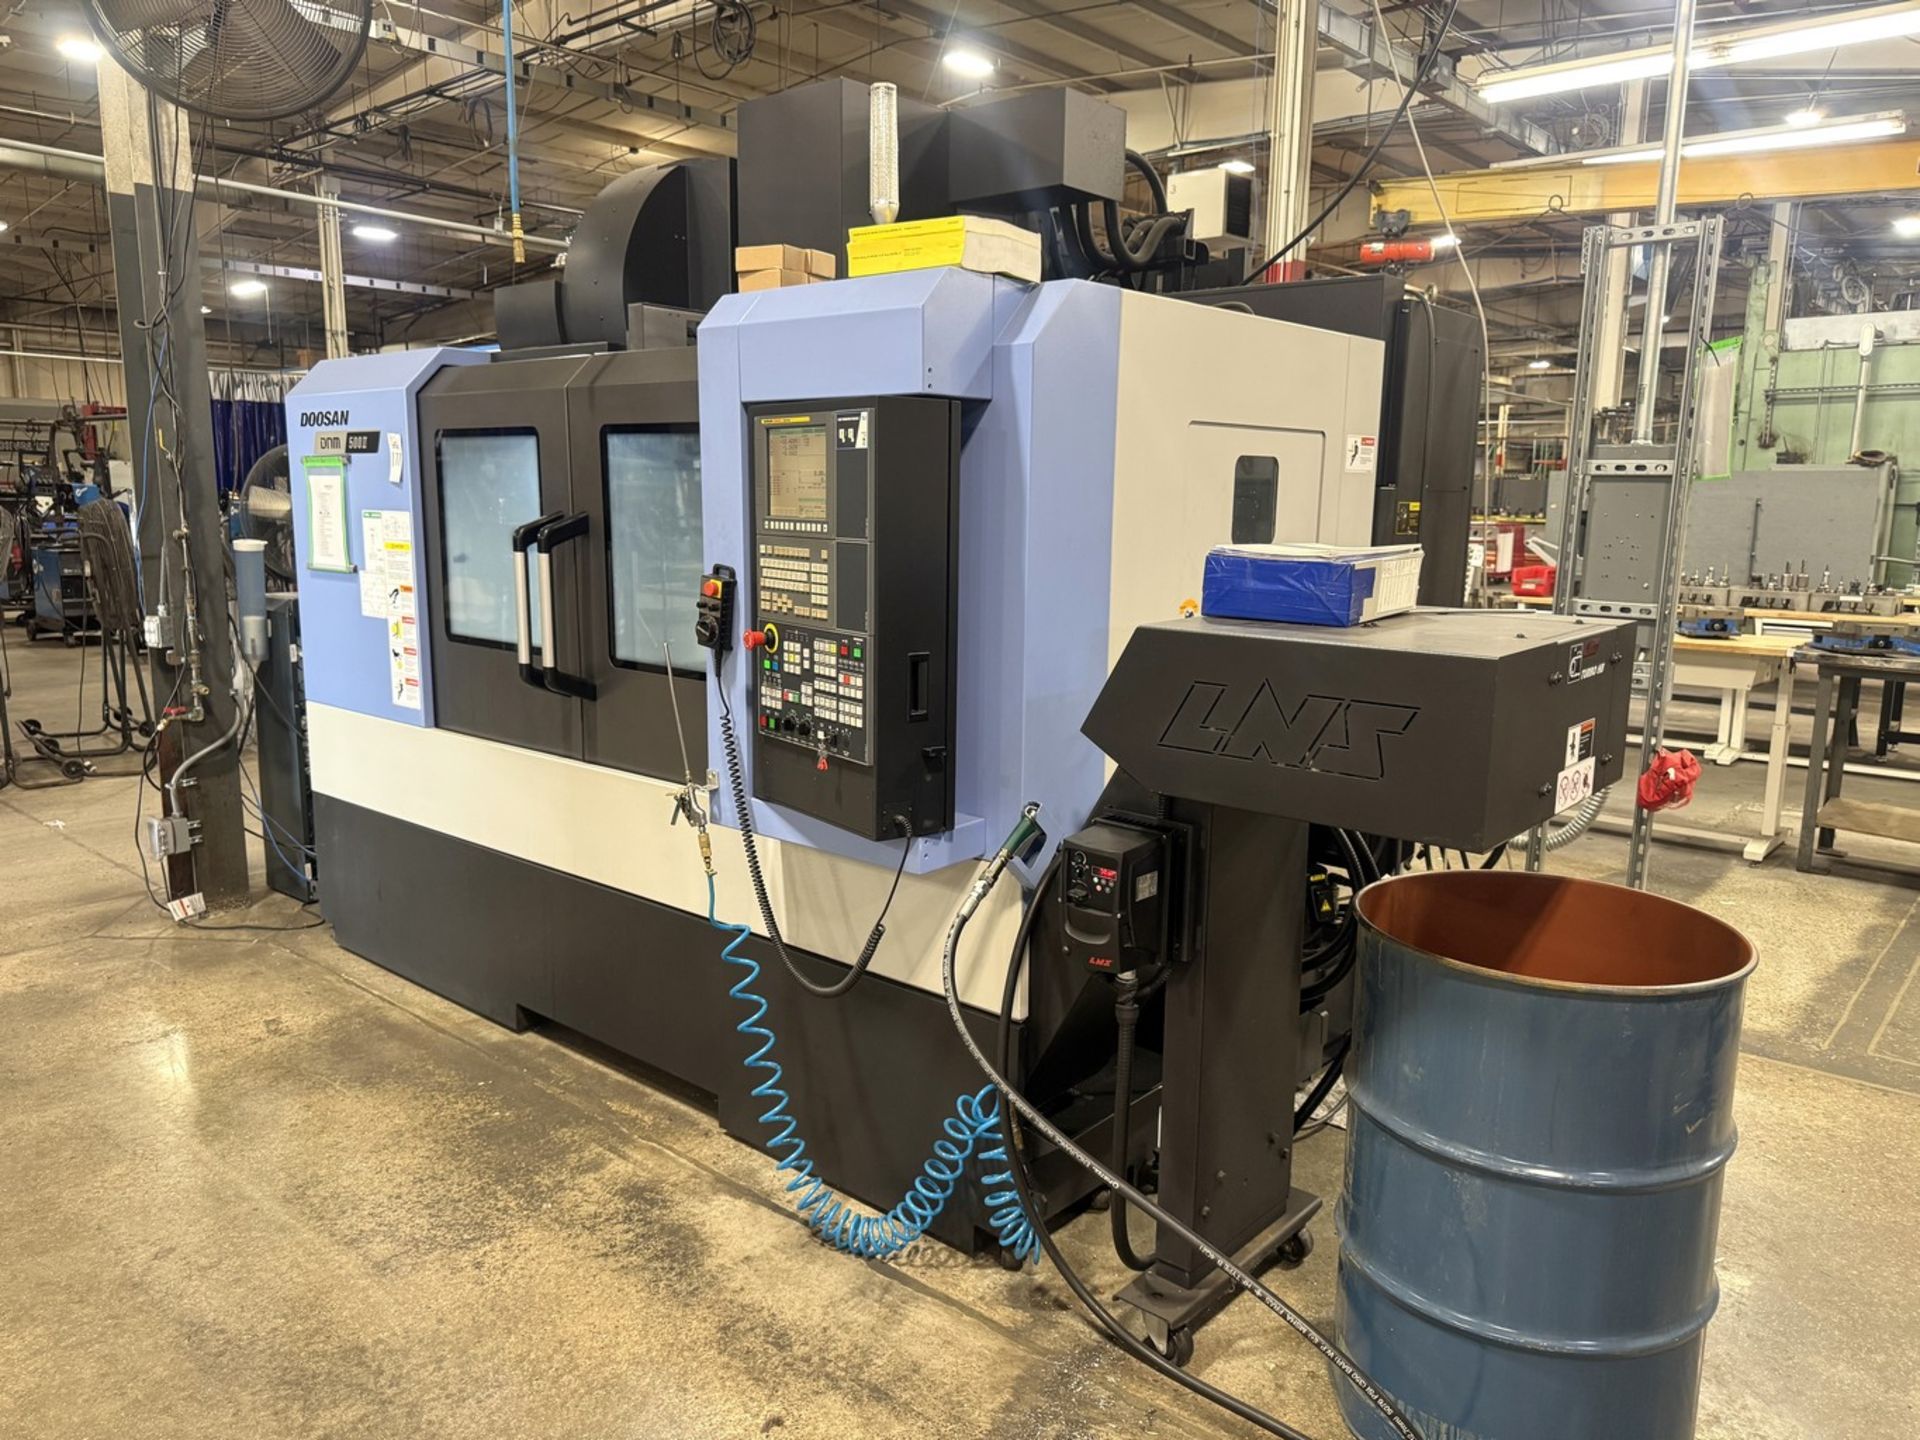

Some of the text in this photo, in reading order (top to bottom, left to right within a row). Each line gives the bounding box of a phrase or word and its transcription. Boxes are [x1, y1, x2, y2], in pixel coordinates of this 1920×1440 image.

[300, 410, 350, 427] DOOSAN
[1158, 678, 1421, 780] LNS
[1364, 1385, 1379, 1400] PSI
